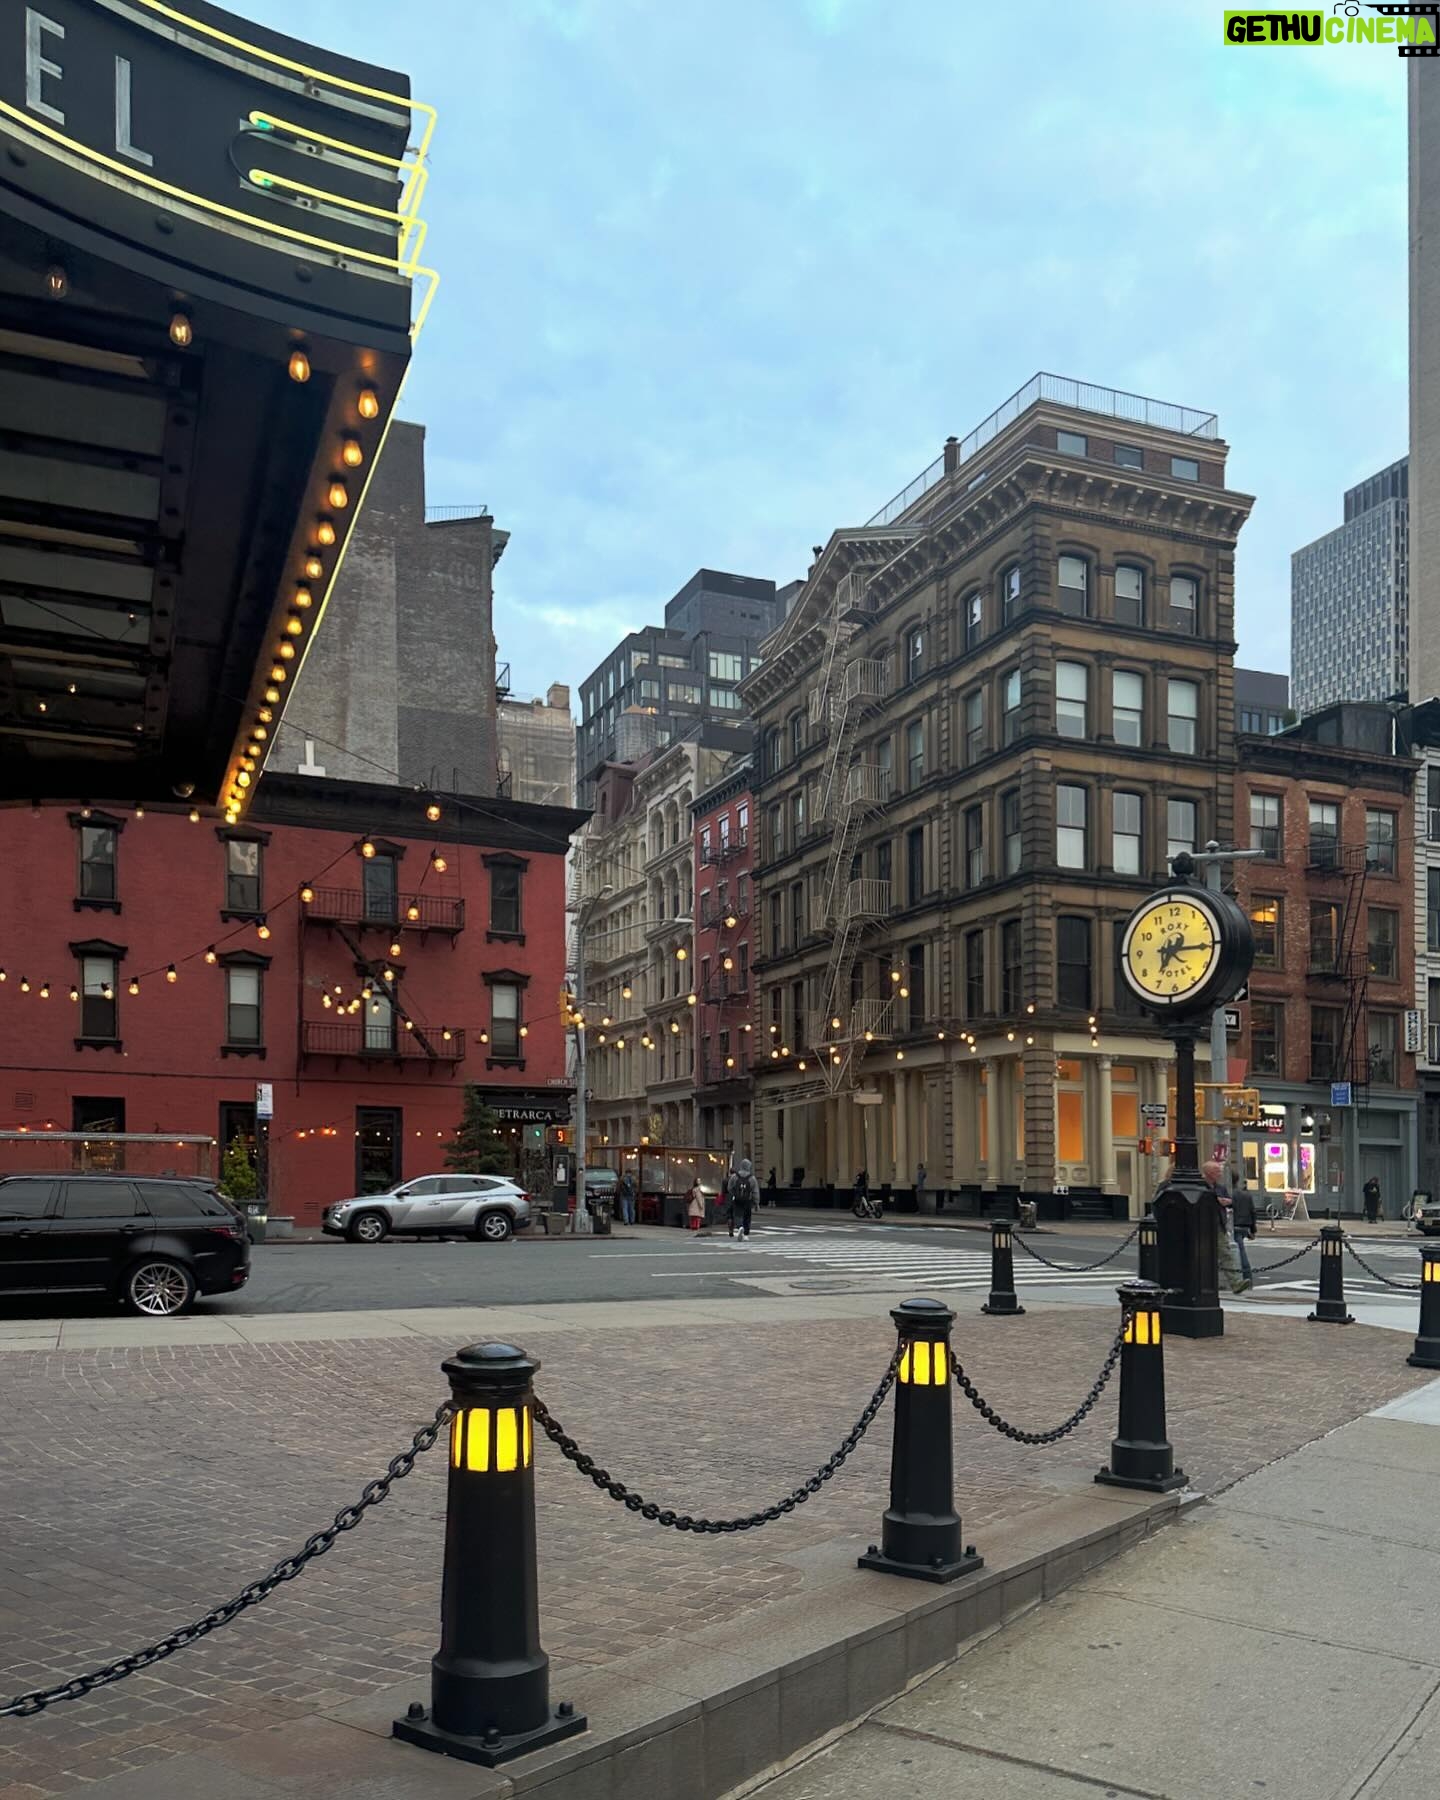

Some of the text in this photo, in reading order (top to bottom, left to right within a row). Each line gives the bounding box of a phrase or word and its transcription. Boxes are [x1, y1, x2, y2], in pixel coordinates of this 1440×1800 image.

[1169, 907, 1180, 917] 12
[1191, 910, 1196, 919] 1
[1154, 917, 1162, 925] 11
[1160, 922, 1189, 935] ROXY
[1202, 922, 1209, 931] 2
[1141, 932, 1152, 941] 10
[1136, 950, 1143, 959] 9
[1142, 968, 1148, 977] 8
[1155, 980, 1162, 989] 7
[1171, 983, 1178, 993] 6
[492, 1109, 552, 1120] PETRARCA
[557, 1130, 564, 1142] 9
